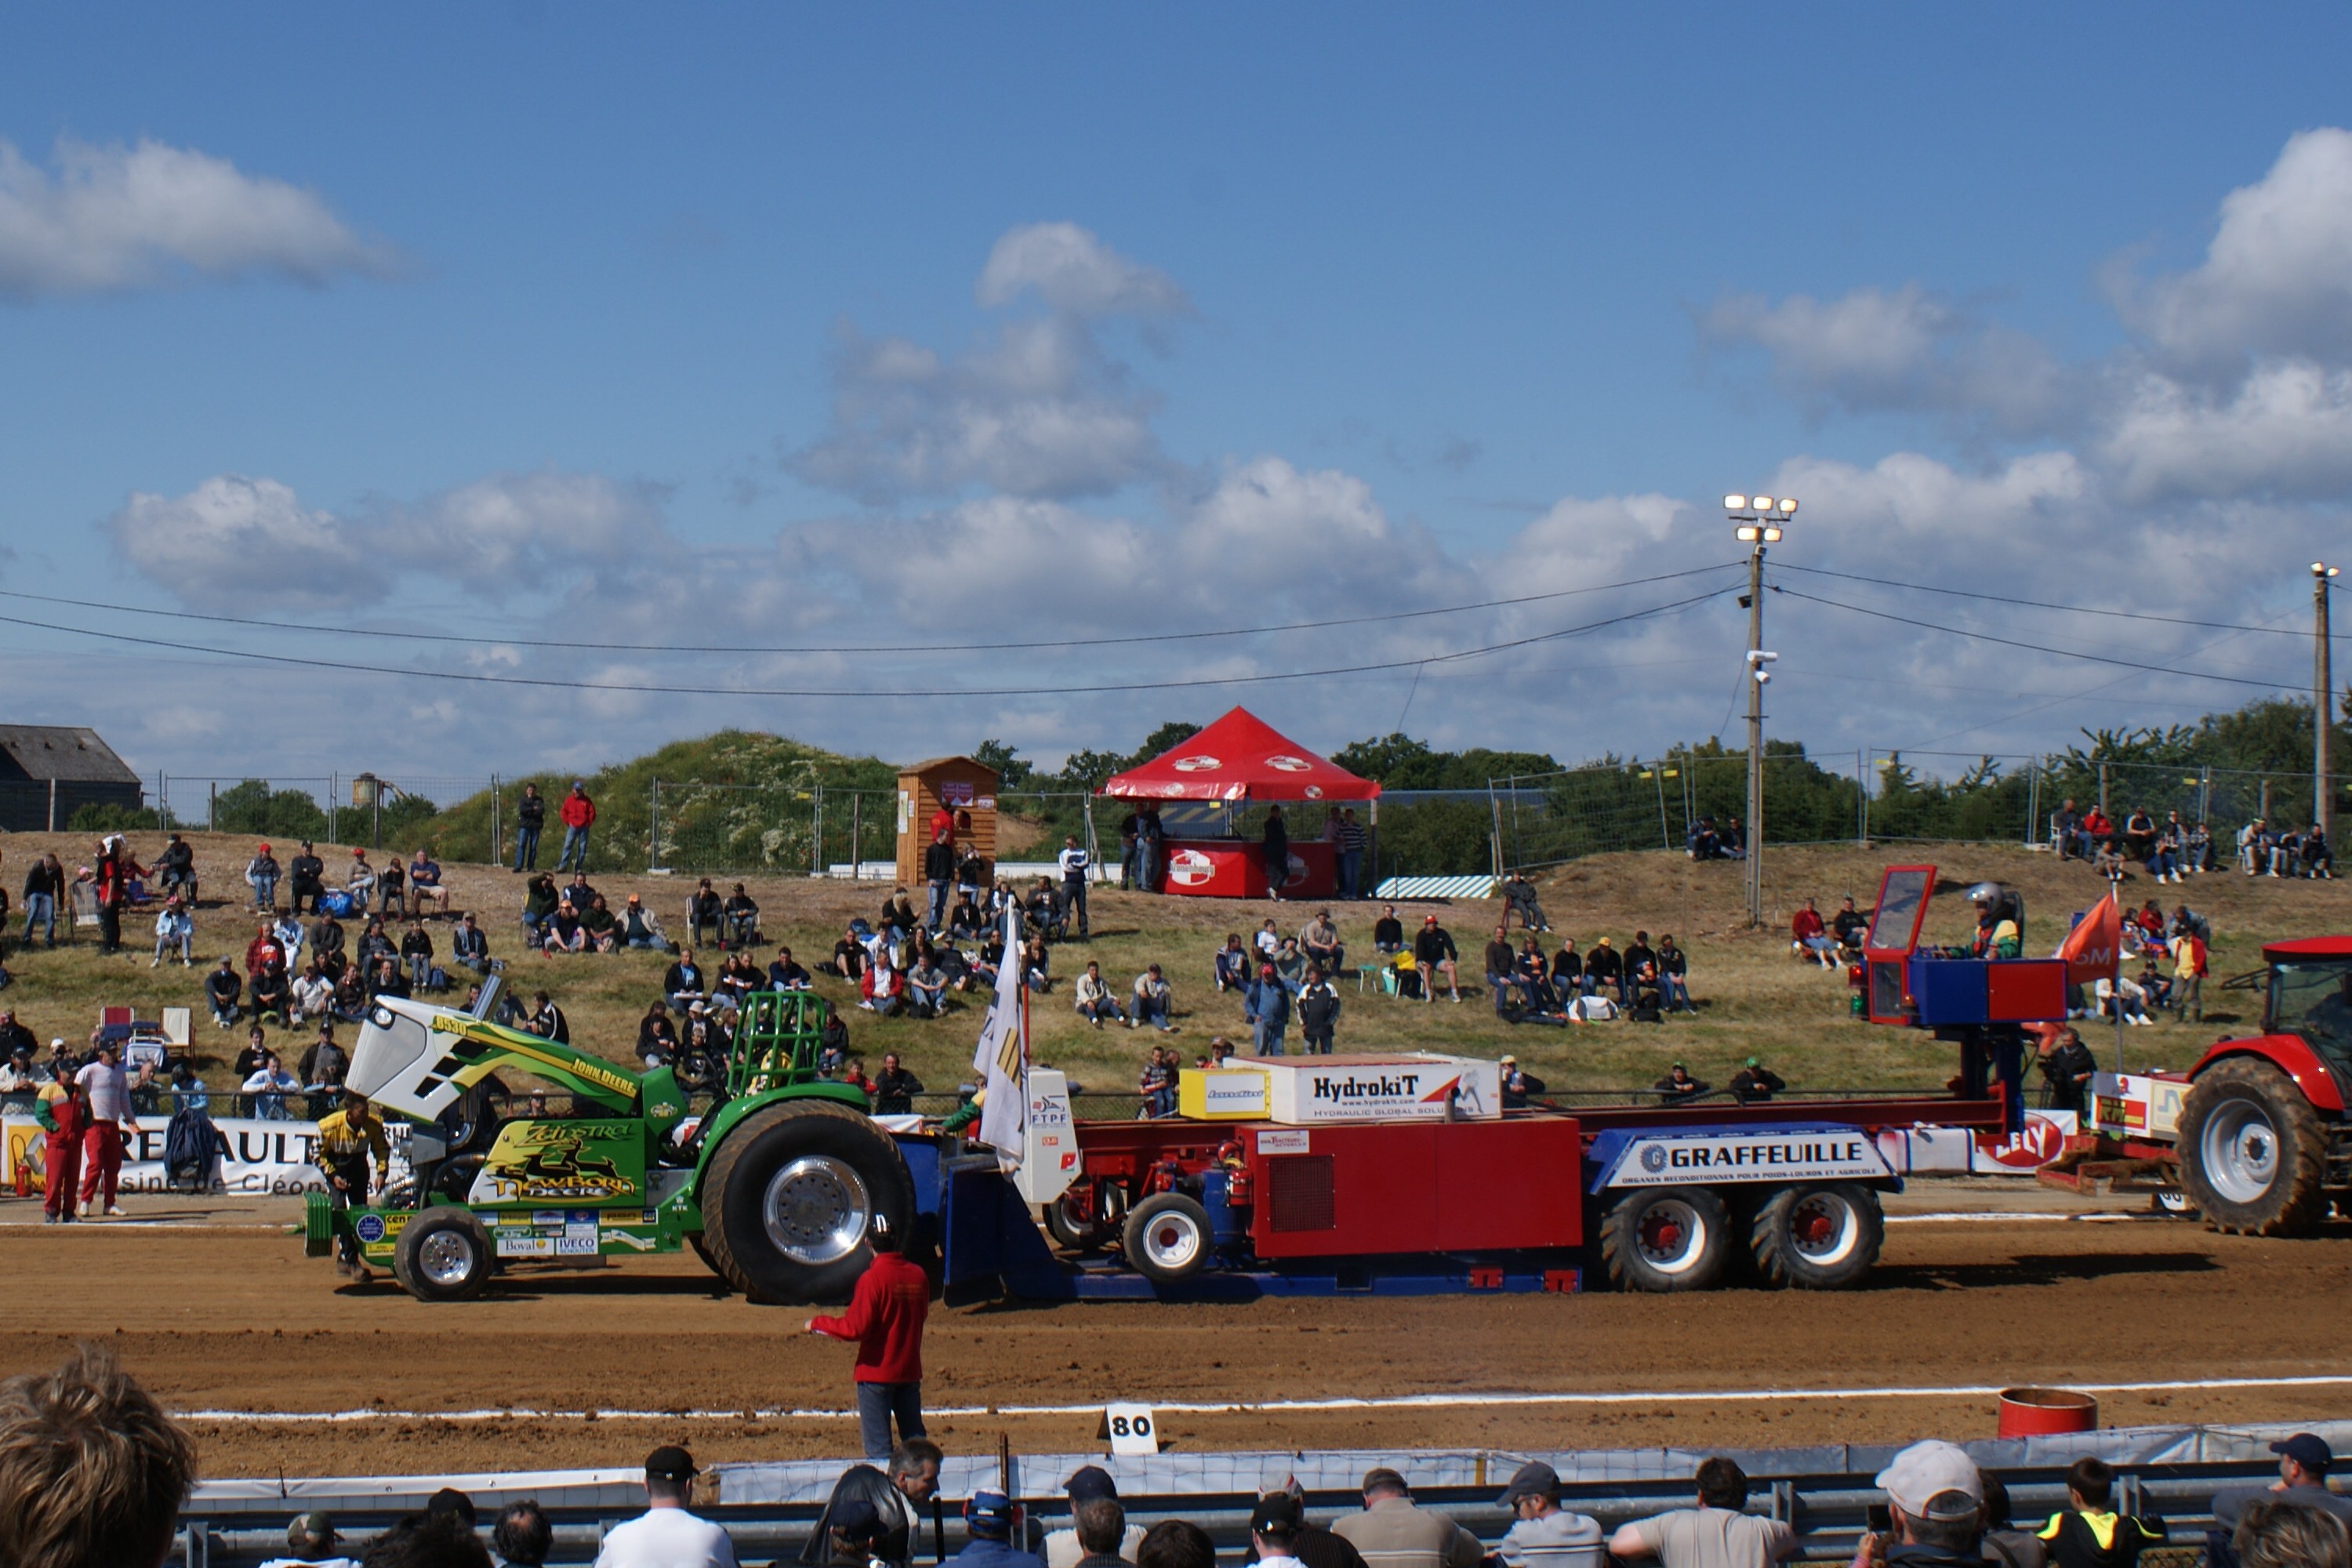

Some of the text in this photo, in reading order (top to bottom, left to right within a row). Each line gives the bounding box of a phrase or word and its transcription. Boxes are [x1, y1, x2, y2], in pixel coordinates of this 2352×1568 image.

[437, 1017, 467, 1036] 8530
[571, 1058, 637, 1094] JOHN DEERE
[1314, 1074, 1419, 1102] HydrokiT
[1341, 1098, 1416, 1106] www.hydrokit.com
[1374, 1109, 1413, 1117] GLOBAL
[1417, 1107, 1474, 1116] SOLUONS
[1671, 1142, 1862, 1167] GRAFFEUILLE
[506, 1240, 535, 1250] Boval
[560, 1239, 594, 1248] IVECO
[1112, 1415, 1151, 1437] 80
